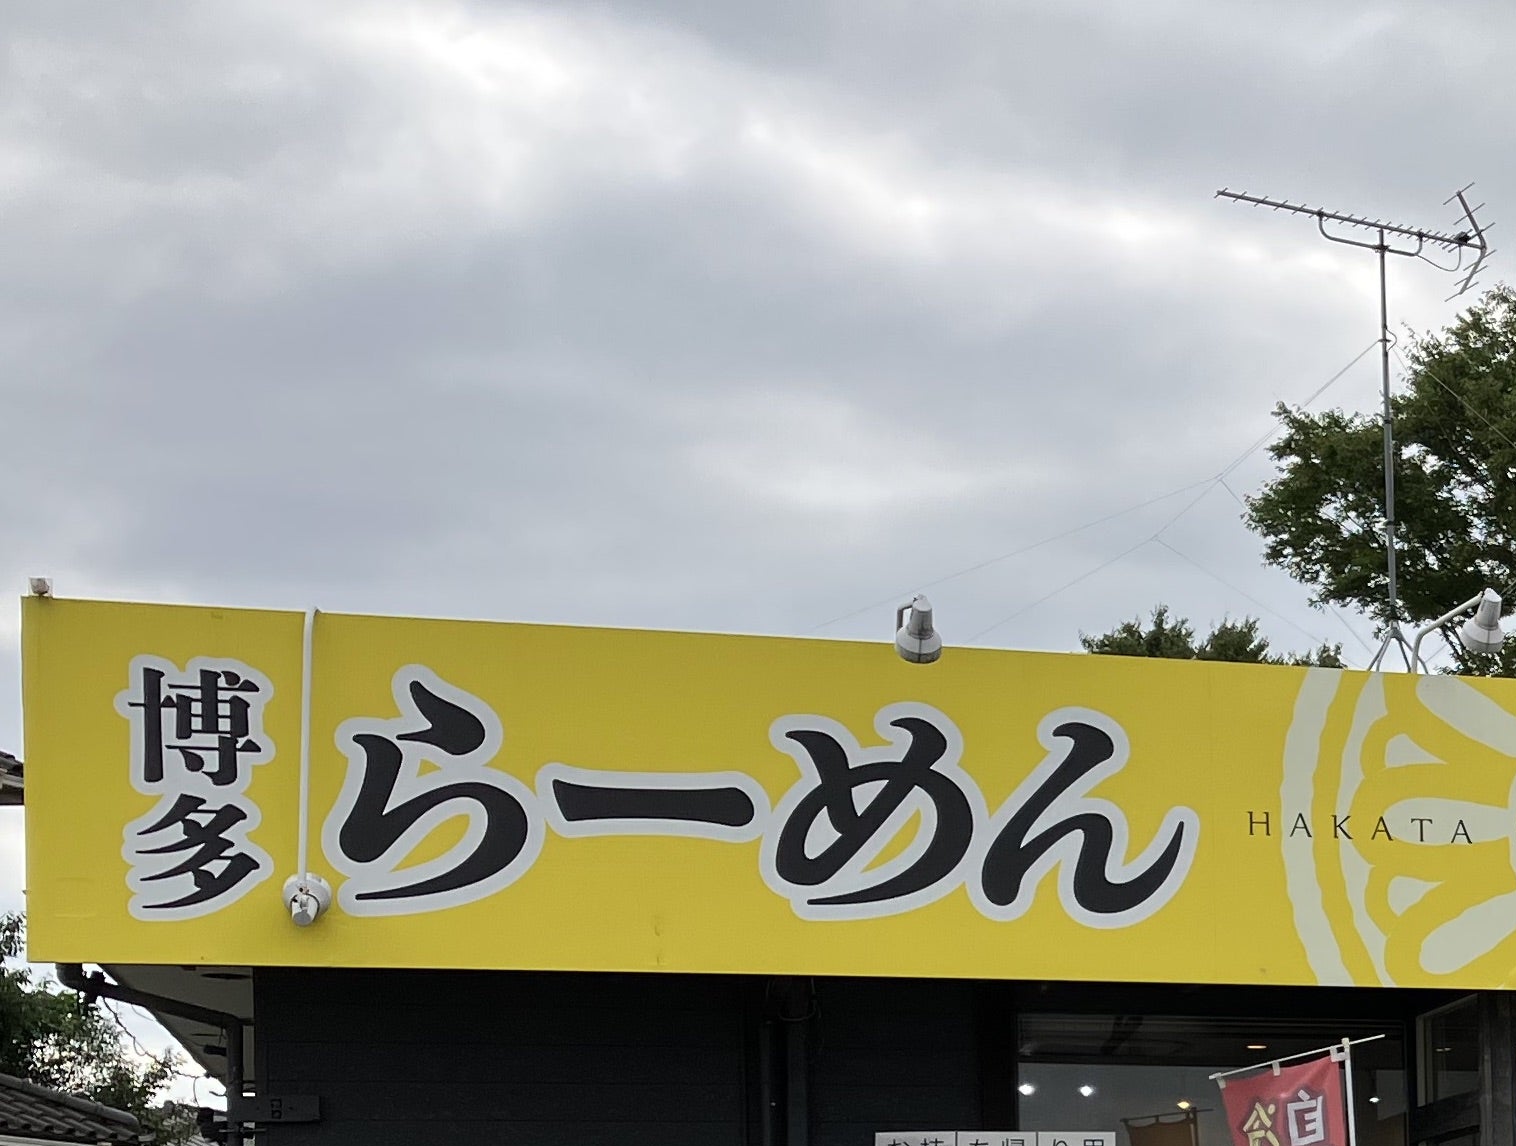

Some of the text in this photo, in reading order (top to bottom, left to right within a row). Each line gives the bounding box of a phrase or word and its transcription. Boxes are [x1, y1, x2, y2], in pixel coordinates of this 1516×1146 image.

[128, 666, 262, 909] 博多
[339, 680, 1184, 913] らーめん
[1247, 811, 1473, 845] HAKATA
